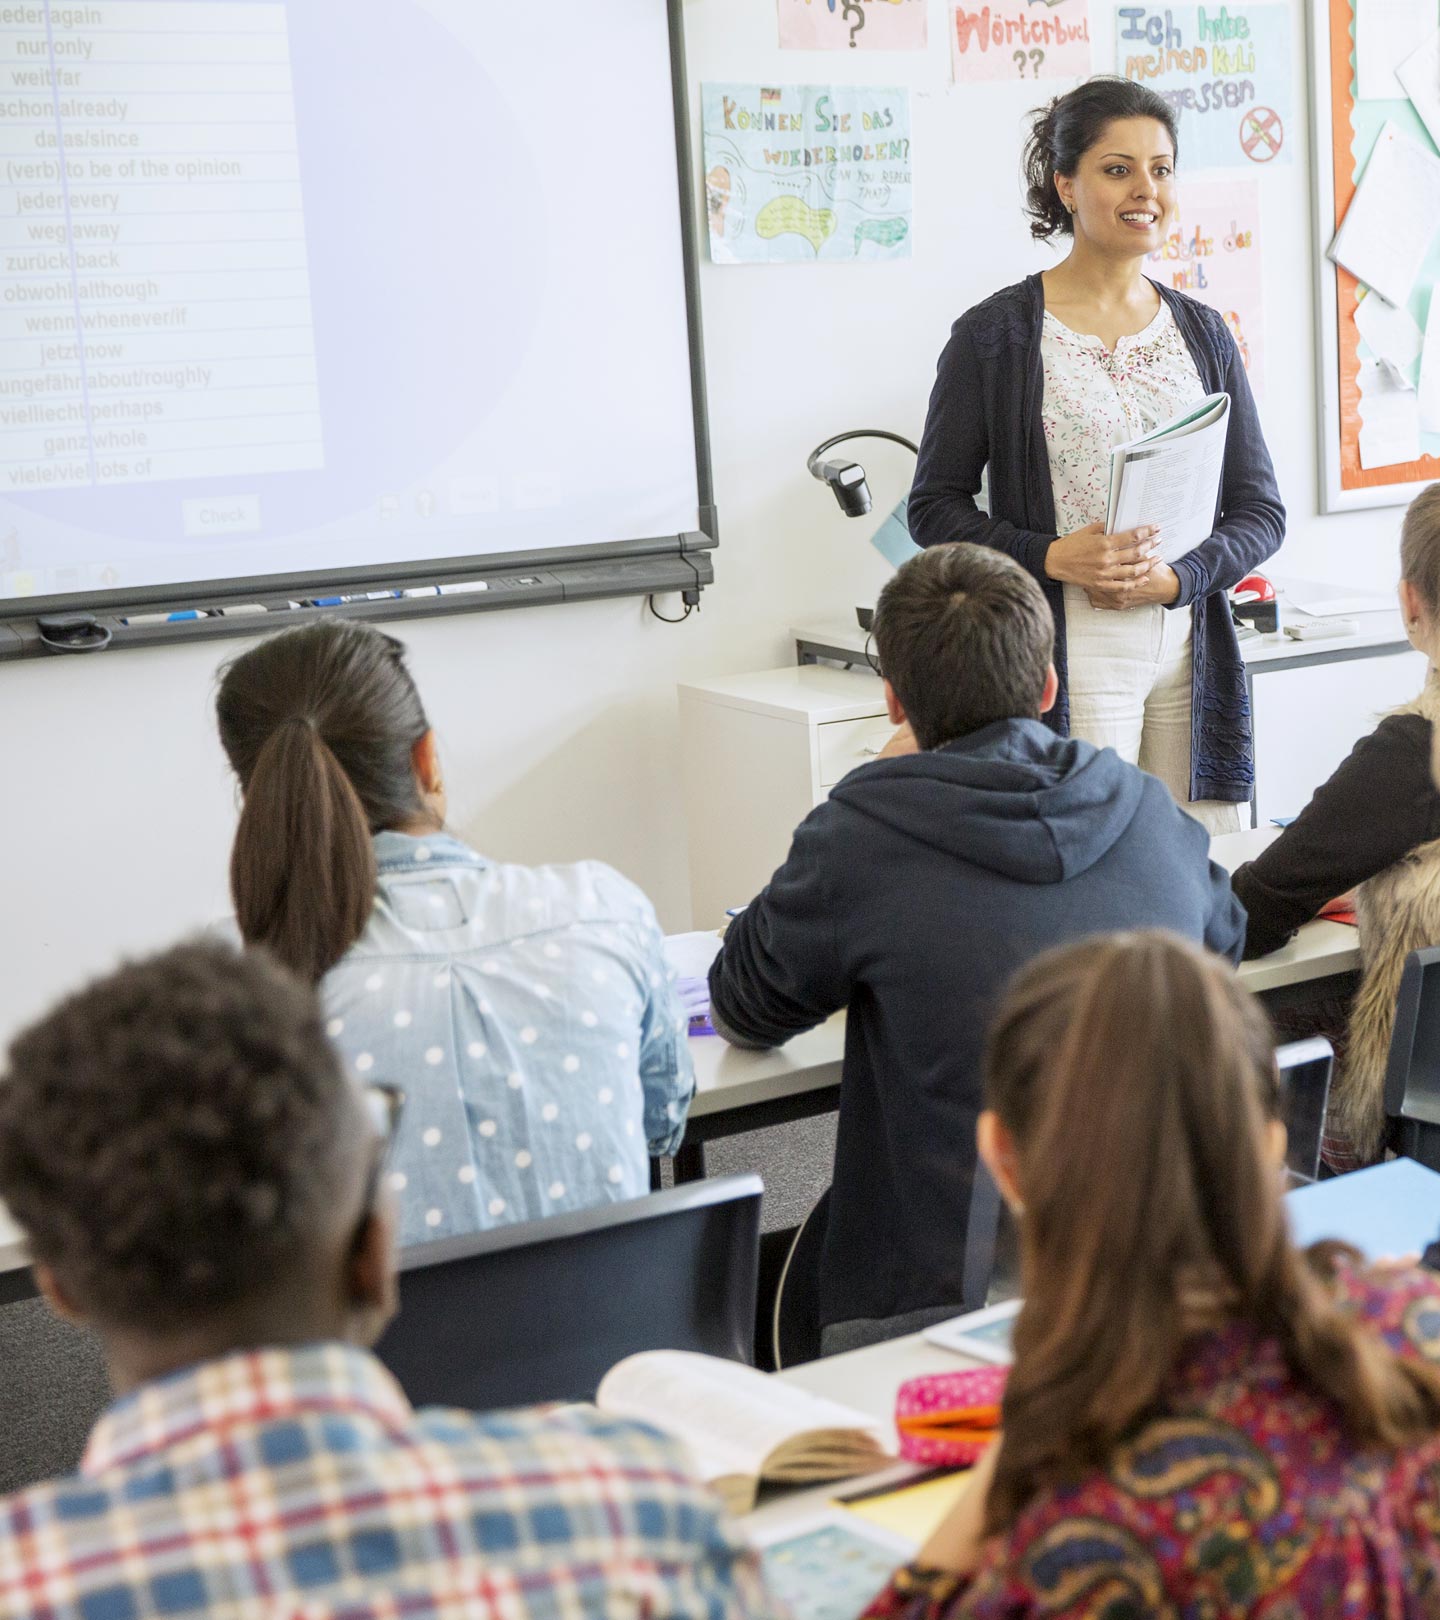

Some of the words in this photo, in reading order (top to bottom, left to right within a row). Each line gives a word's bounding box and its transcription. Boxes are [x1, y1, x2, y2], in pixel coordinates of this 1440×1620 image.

[0, 4, 46, 24] eder
[50, 7, 102, 29] again
[1118, 8, 1182, 48] Ich
[1198, 5, 1250, 42] habe
[16, 40, 50, 55] nur
[53, 37, 94, 60] only
[1012, 47, 1045, 80] ??
[11, 69, 51, 86] weit
[55, 68, 81, 86] far
[0, 98, 54, 117] schon
[60, 98, 128, 121] already
[1160, 79, 1255, 121] gessen
[35, 130, 58, 148] da
[63, 129, 140, 147] as/since
[6, 160, 61, 183] (verb)
[66, 161, 84, 178] to
[90, 160, 112, 178] be
[118, 159, 136, 177] of
[140, 159, 169, 177] the
[175, 157, 242, 181] opinion
[15, 190, 64, 216] jeder
[70, 191, 119, 212] every
[27, 223, 68, 244] weg
[72, 223, 120, 242] away
[6, 252, 71, 272] zurück
[75, 250, 120, 269] back
[4, 282, 74, 303] obwohl
[78, 279, 159, 302] although
[24, 313, 76, 332] wenn
[81, 307, 188, 329] whenever/if
[40, 343, 82, 367] jetzt
[84, 343, 123, 359] now
[87, 365, 213, 391] about/roughly
[90, 400, 164, 422] perhaps
[43, 434, 89, 457] ganz
[93, 429, 148, 450] whole
[96, 460, 129, 478] lots
[134, 457, 153, 476] of
[199, 507, 246, 525] Check
